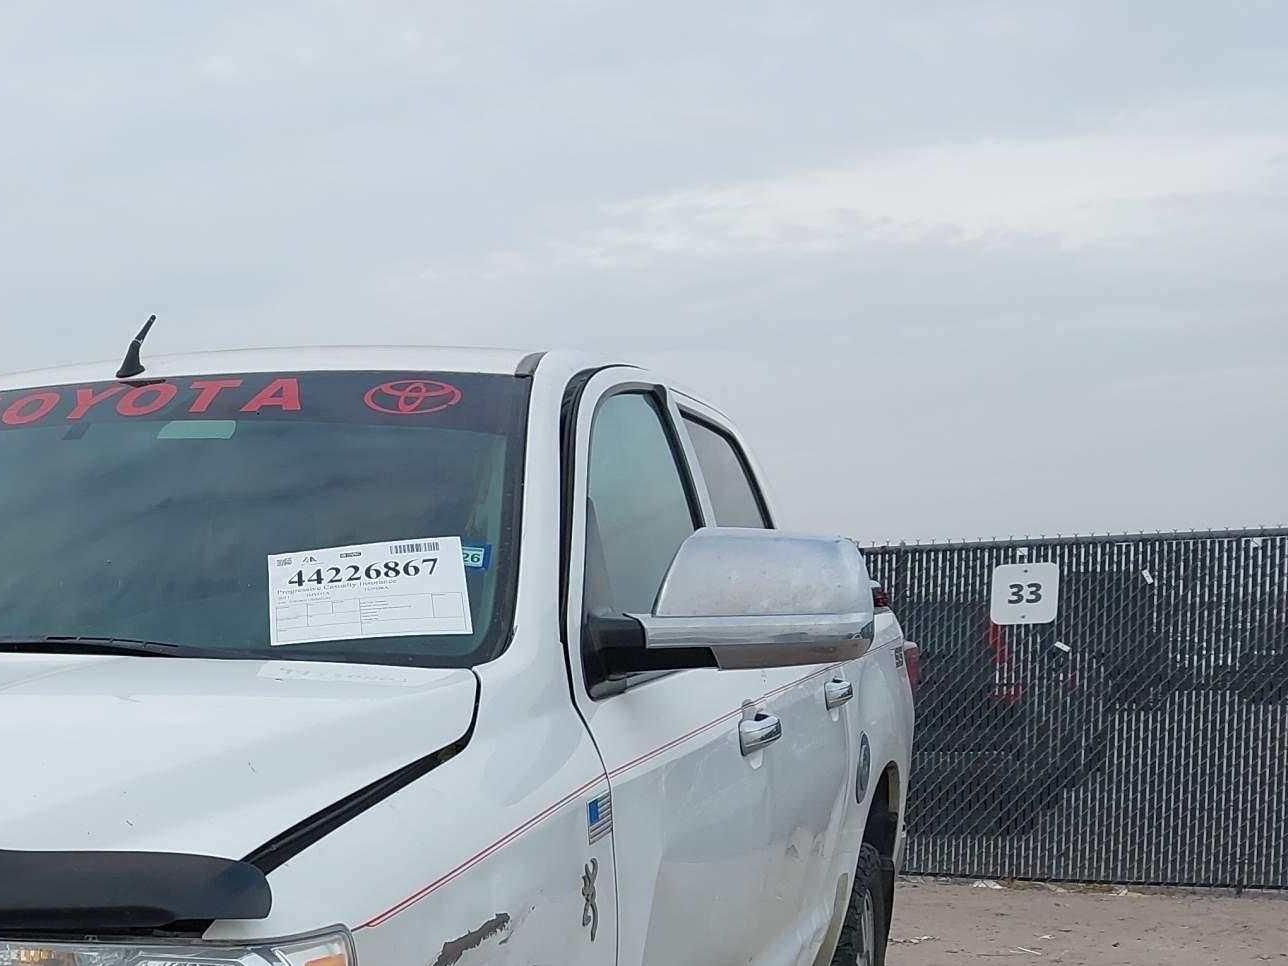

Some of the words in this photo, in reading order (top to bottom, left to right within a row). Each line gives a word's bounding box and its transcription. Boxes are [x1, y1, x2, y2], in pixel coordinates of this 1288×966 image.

[463, 552, 481, 563] 26
[288, 558, 438, 587] 44226867
[1007, 582, 1043, 605] 33
